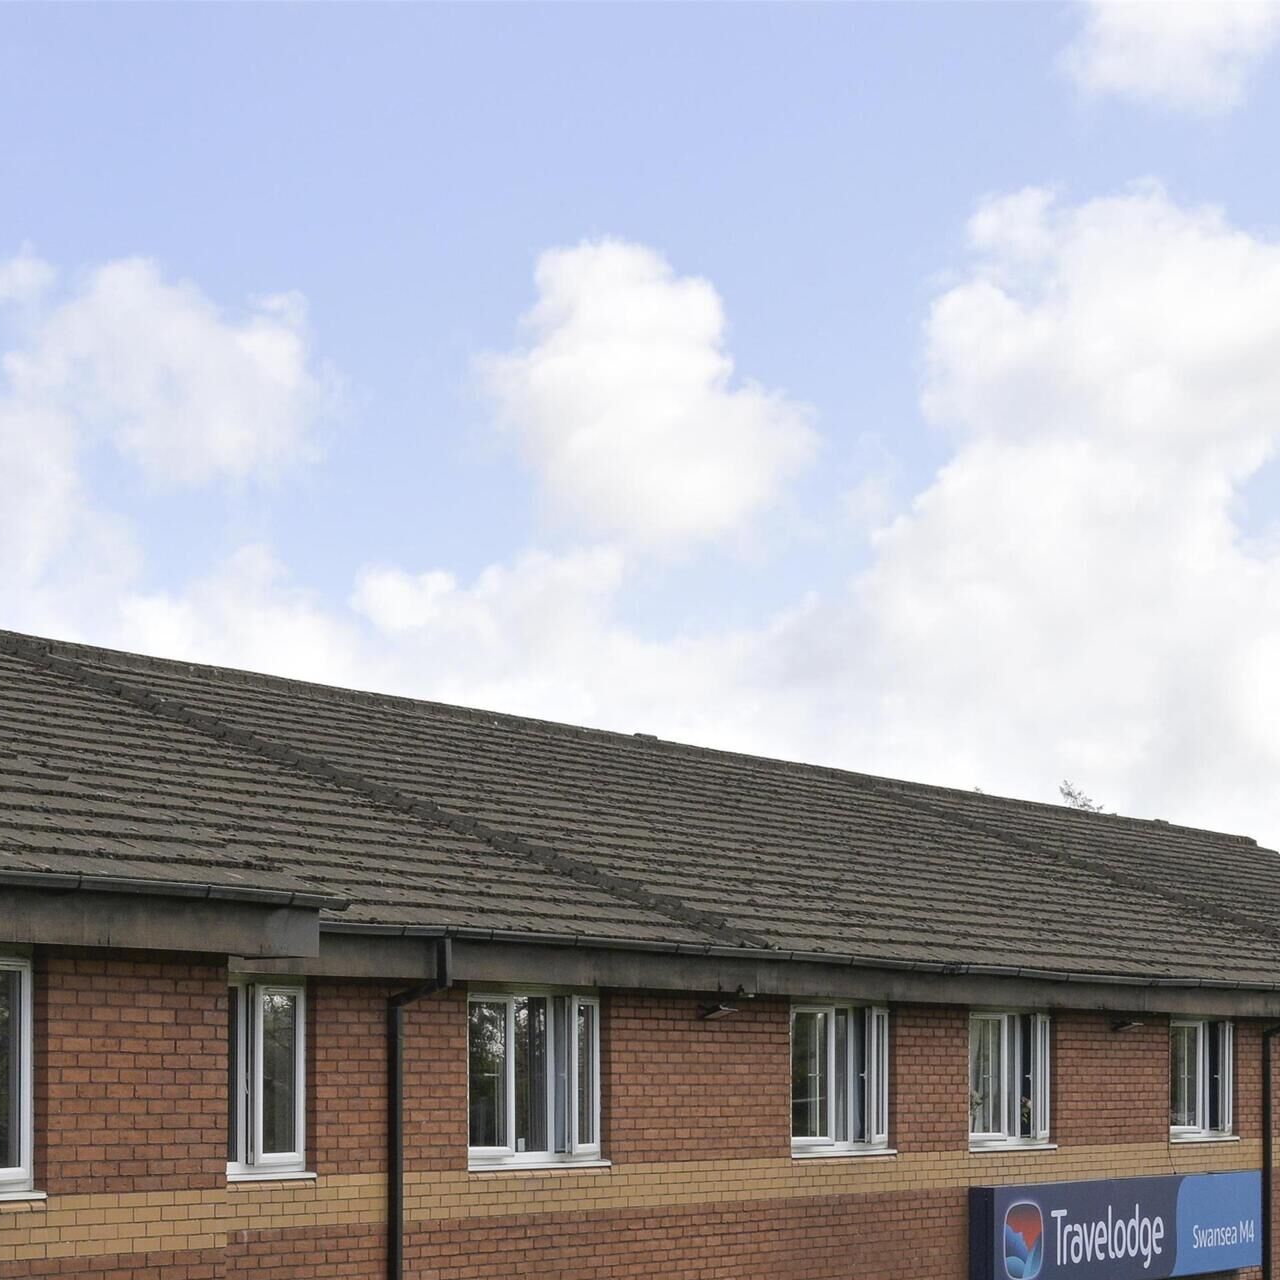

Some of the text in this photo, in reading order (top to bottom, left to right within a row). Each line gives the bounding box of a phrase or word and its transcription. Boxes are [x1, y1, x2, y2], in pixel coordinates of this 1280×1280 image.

[1051, 1203, 1164, 1269] Travelodge
[1192, 1220, 1255, 1249] Swansea M4
